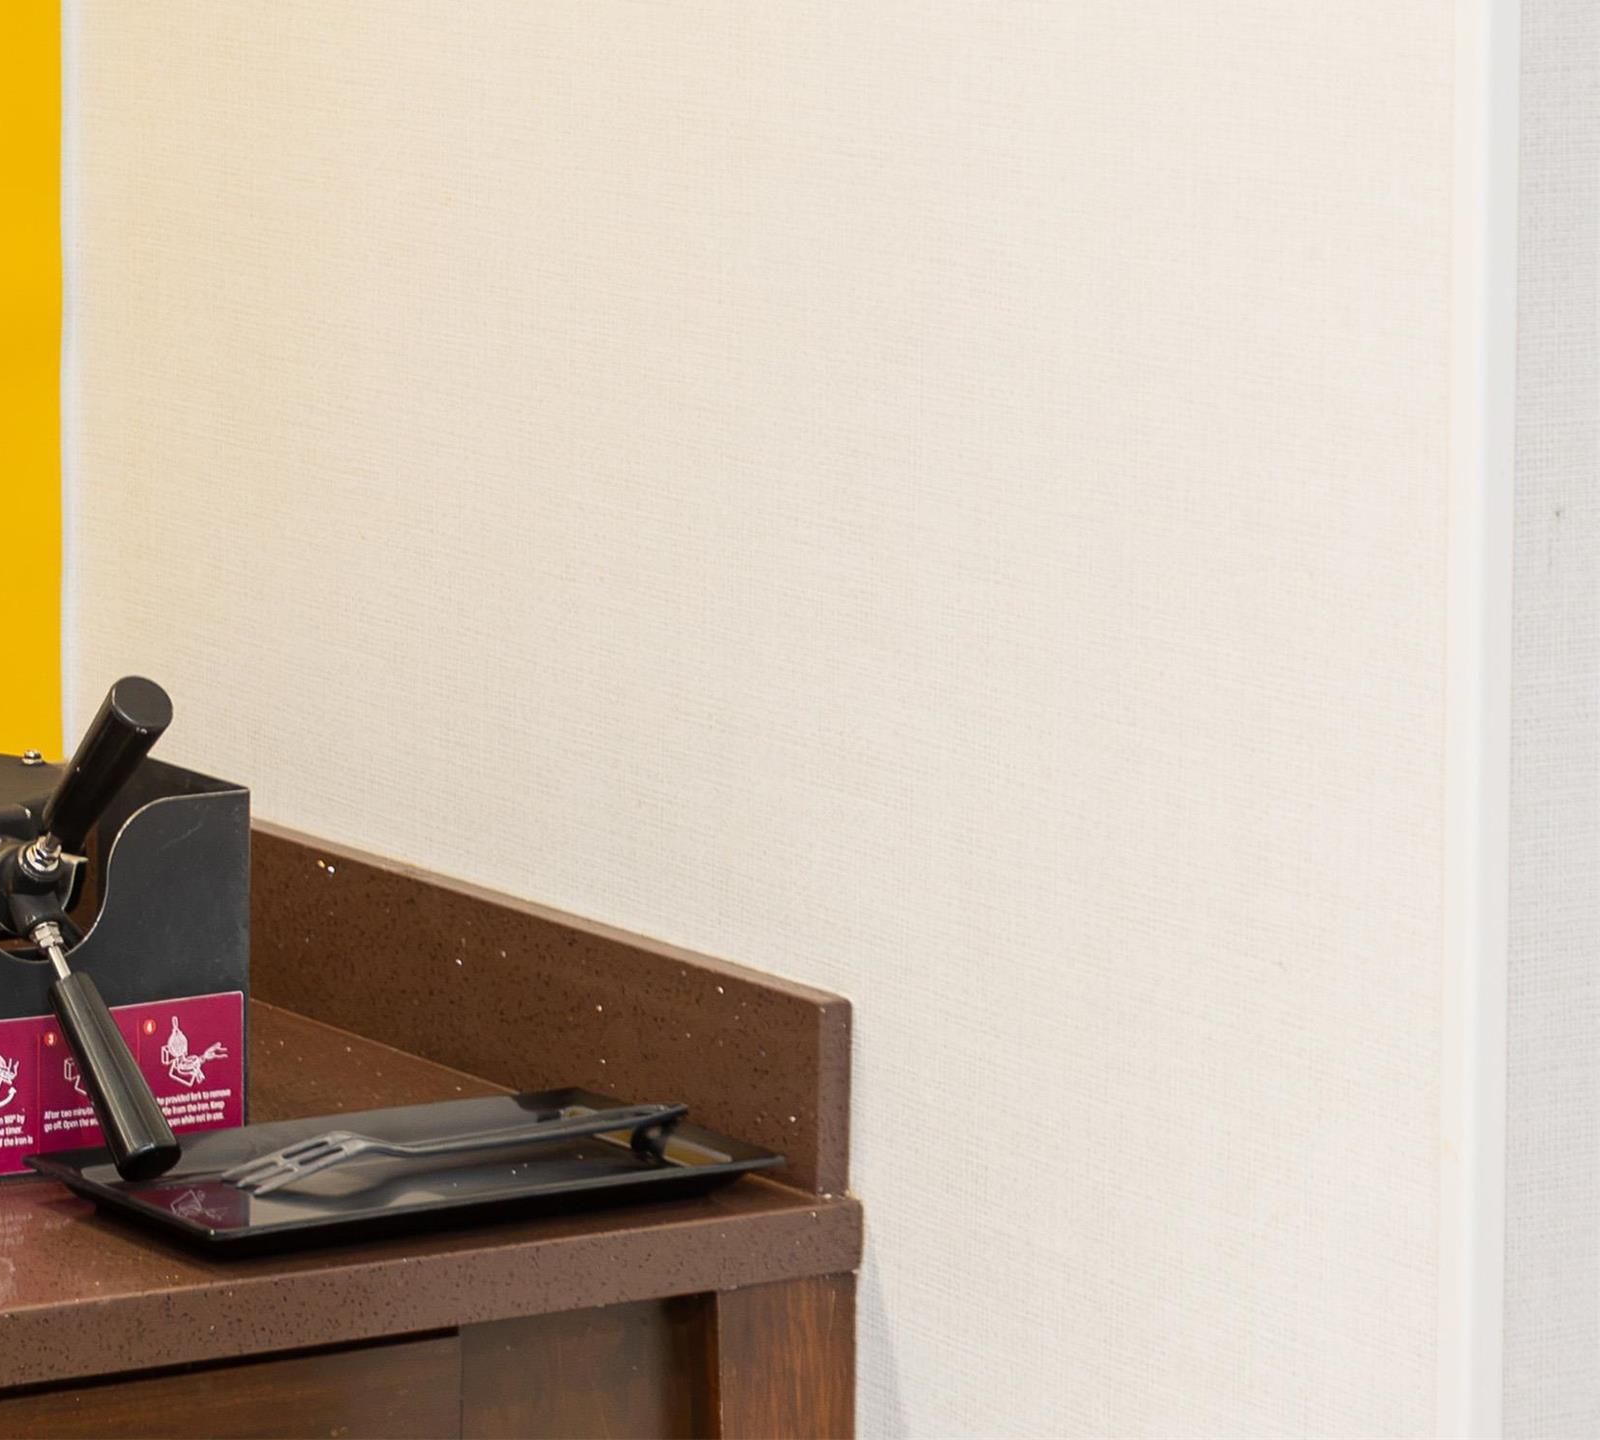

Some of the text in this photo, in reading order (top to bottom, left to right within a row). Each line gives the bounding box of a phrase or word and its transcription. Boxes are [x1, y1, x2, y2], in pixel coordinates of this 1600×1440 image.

[48, 1033, 54, 1046] 3
[165, 1093, 191, 1106] provided
[203, 1091, 209, 1100] to
[210, 1089, 231, 1098] remove
[44, 1110, 60, 1120] After
[61, 1110, 72, 1118] two
[187, 1104, 197, 1113] the
[17, 1113, 25, 1125] by
[44, 1123, 53, 1133] go
[63, 1120, 79, 1131] Open
[79, 1118, 89, 1128] the
[0, 1138, 3, 1148] if
[3, 1137, 14, 1147] the
[15, 1136, 27, 1146] iron
[27, 1135, 34, 1145] is
